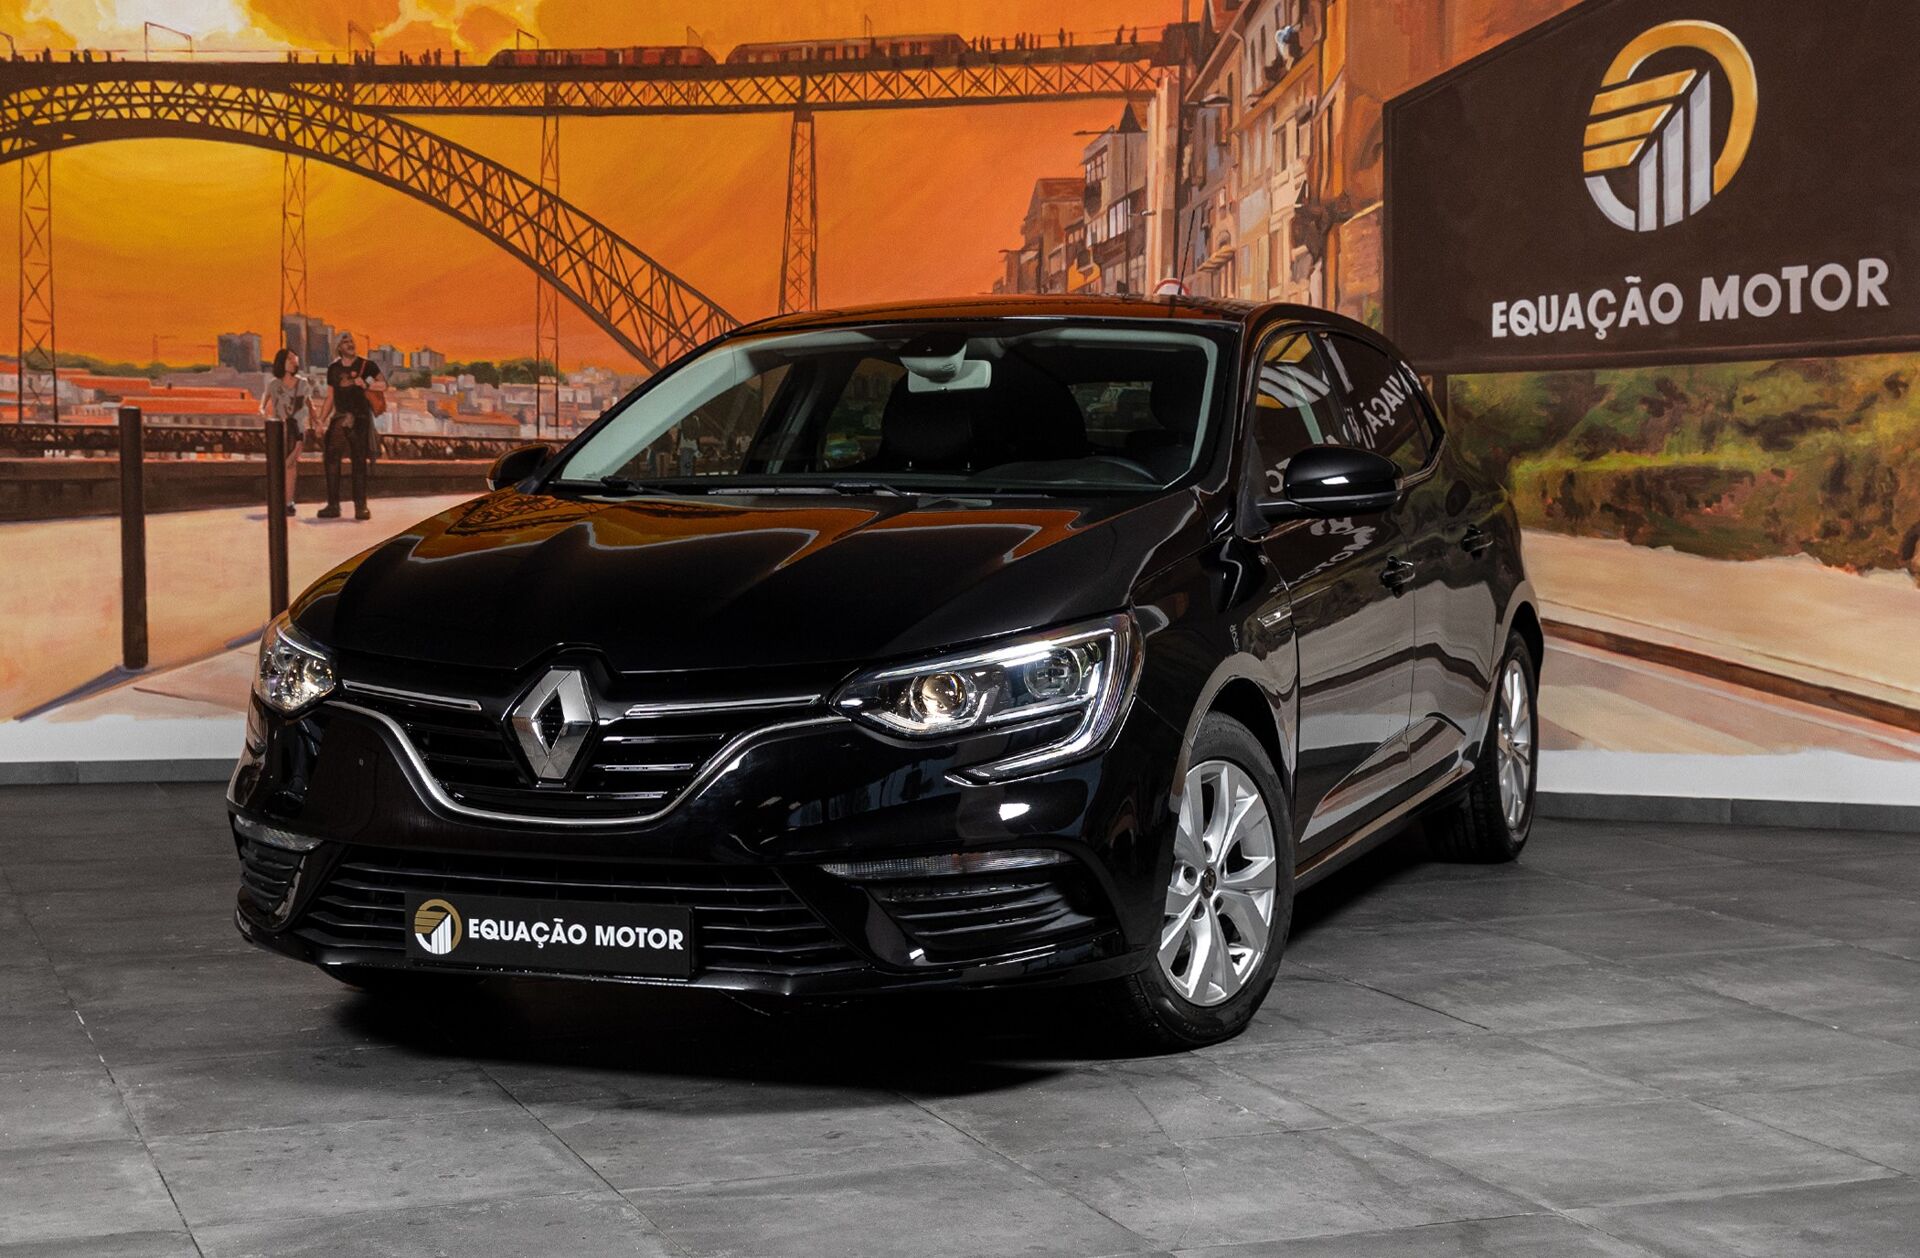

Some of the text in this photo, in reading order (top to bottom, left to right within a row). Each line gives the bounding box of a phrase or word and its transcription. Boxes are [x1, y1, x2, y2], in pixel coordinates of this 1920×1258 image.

[1491, 257, 1890, 340] EQUAÇÃO MOTOR
[468, 917, 684, 950] EQUAÇÃO MOTOR
